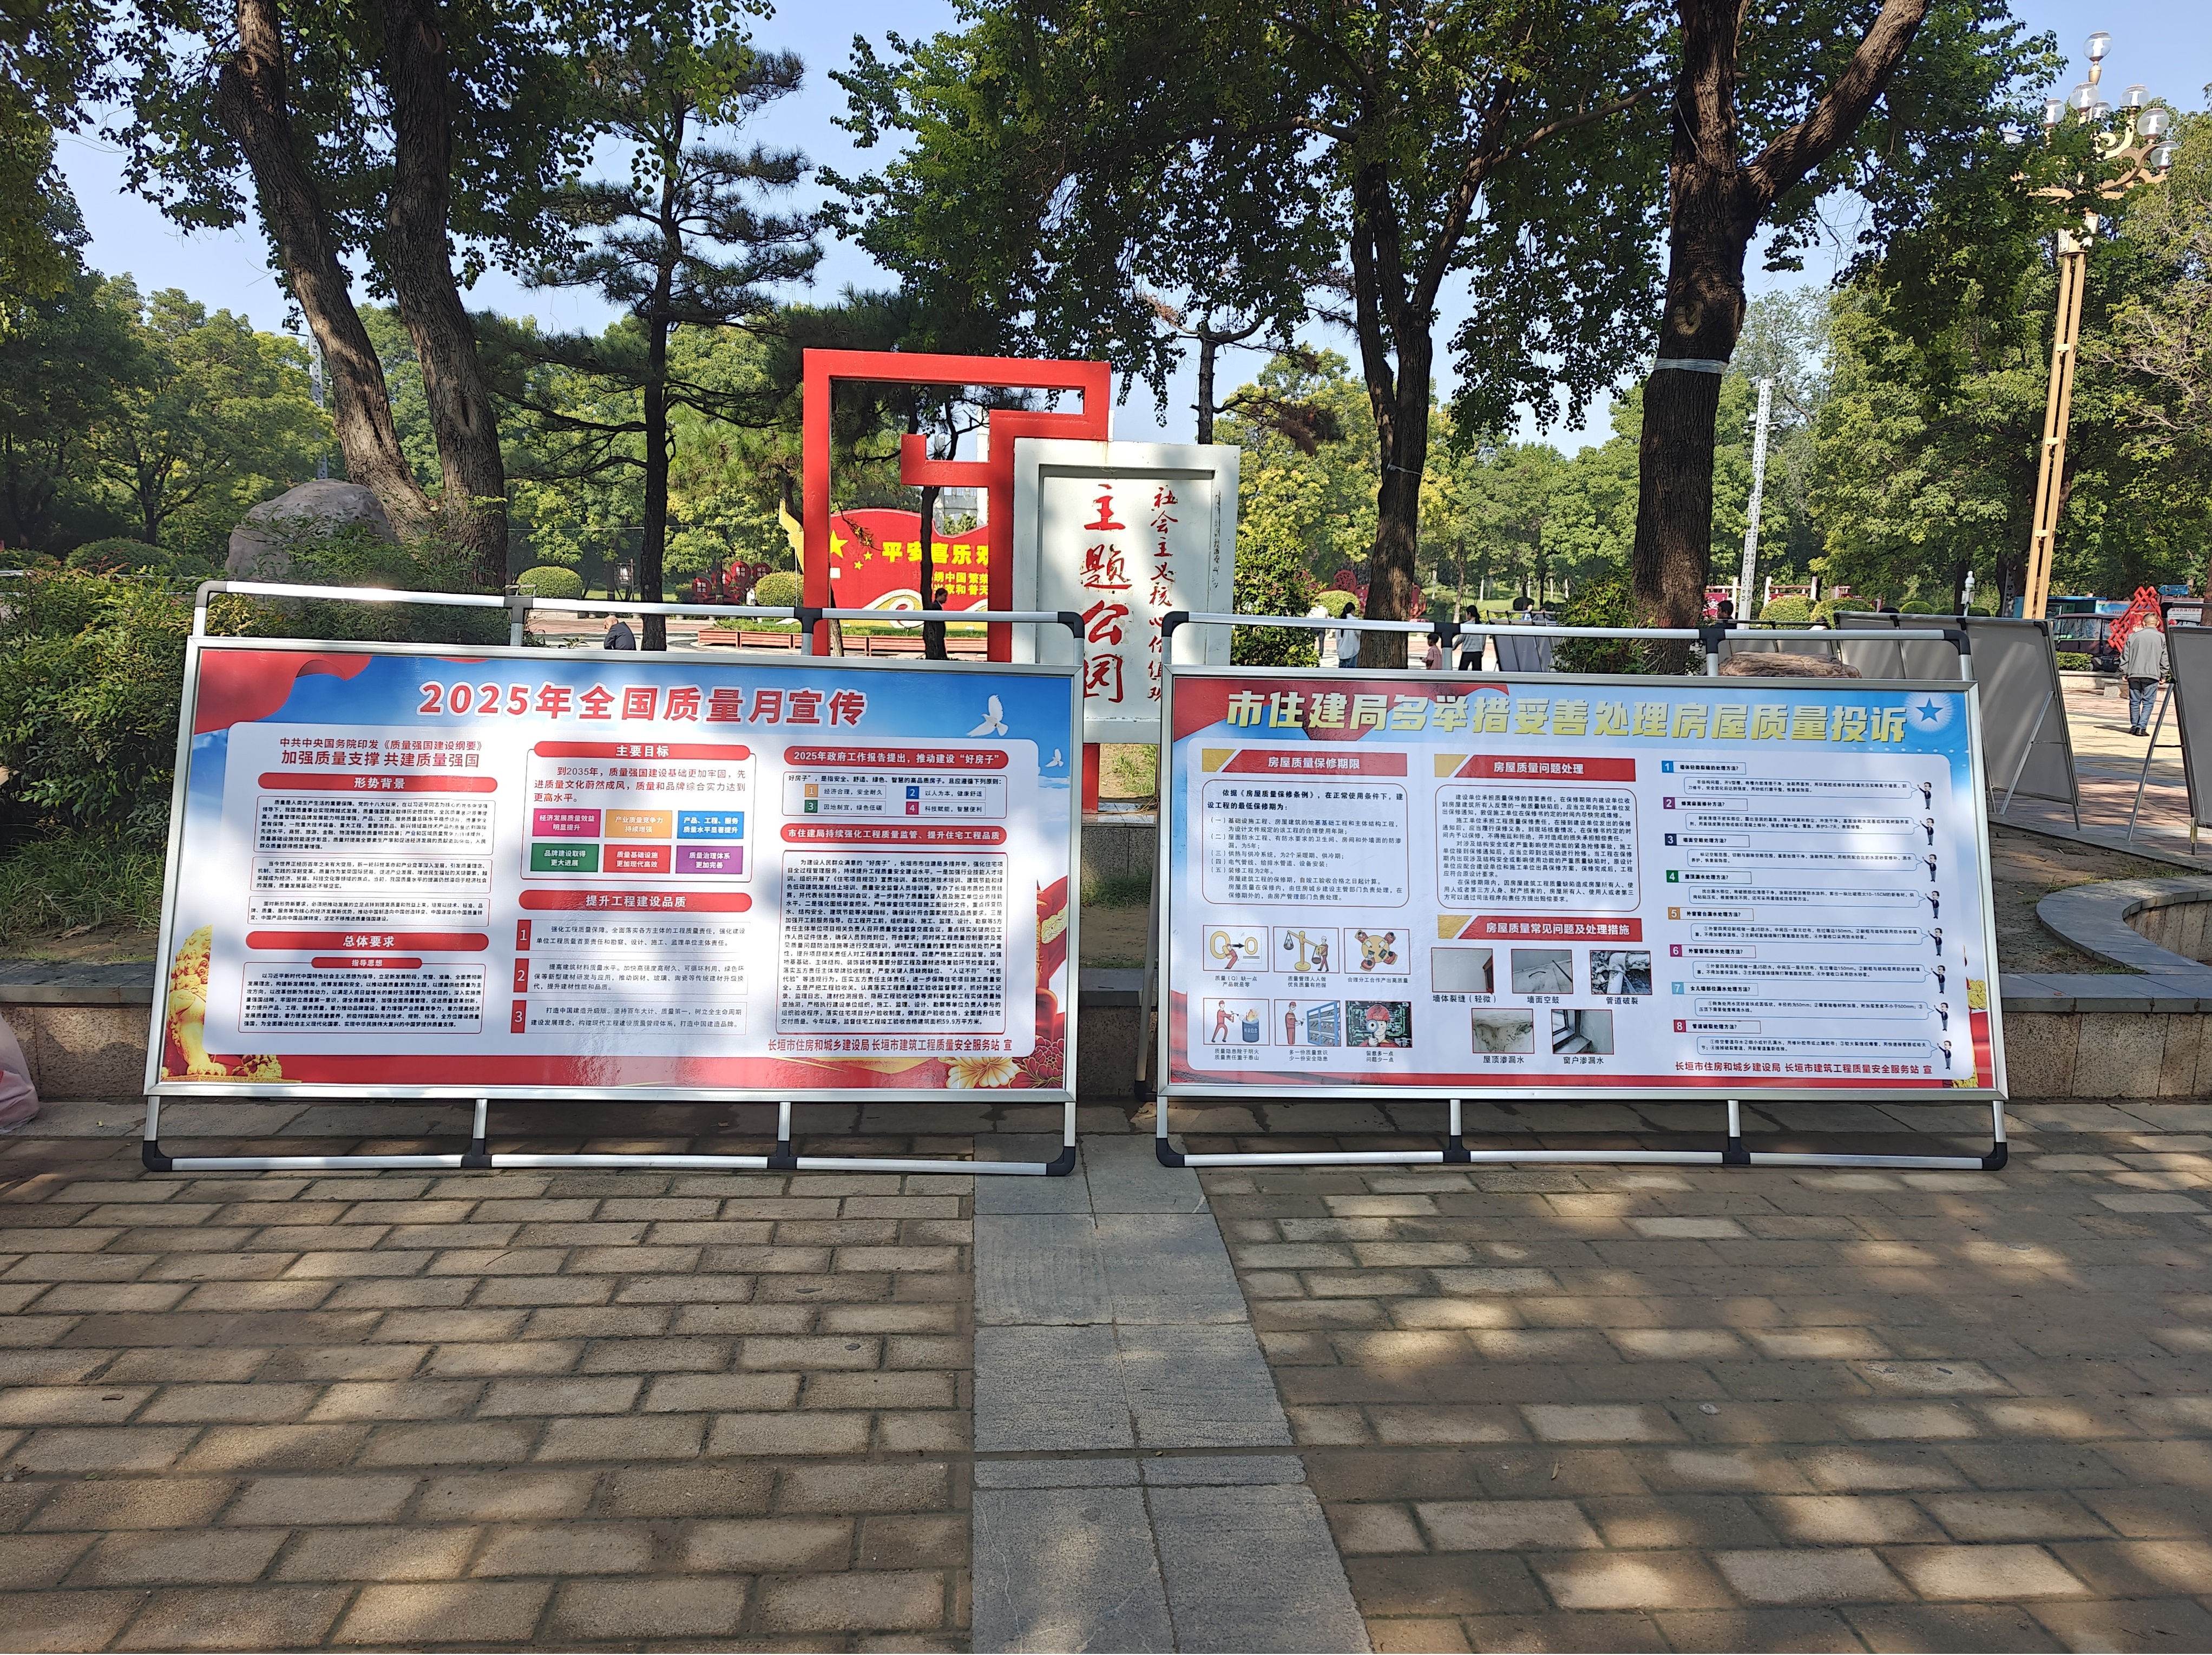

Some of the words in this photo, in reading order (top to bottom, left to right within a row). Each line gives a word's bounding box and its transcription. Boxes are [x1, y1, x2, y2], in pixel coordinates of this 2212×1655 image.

[931, 571, 966, 583] 绣中国
[931, 583, 966, 595] 家和
[1079, 483, 1132, 703] 主题公园
[417, 682, 867, 727] 2025年全国质量月宣传
[1227, 690, 1907, 743] 市住建局多举措妥善处理房屋质量投诉
[279, 737, 483, 751] 中共中央国务院印发《质量强国建设纲要》
[615, 745, 669, 757] 主要目标
[281, 750, 380, 767] 加强质量支撑
[383, 753, 480, 768] 共建质量强国
[793, 752, 1000, 764] 2025年政府工作报告提出，推动建设“好房子”
[1268, 756, 1361, 770] 房屋质量保修期限
[1665, 763, 1670, 771] 1
[556, 766, 746, 779] 到2035年，质量强国建设基础更加牢固，先
[1494, 762, 1584, 775] 房屋质量问题处理
[353, 776, 406, 789] 形势背景
[534, 779, 746, 792] 进质量文化蔚然成风，质量和品牌综合实力达到
[909, 788, 916, 796] 2
[1222, 789, 1404, 801] 依据《房屋质量保修条例》，在正常使用条件下，建
[534, 793, 578, 802] 更高水平。
[808, 802, 814, 810] 3
[823, 803, 883, 812] 因地制宜，绿色低碳
[1207, 801, 1288, 811] 设工程的最低保修期为：
[1666, 799, 1672, 807] 2
[909, 804, 916, 812] 4
[539, 814, 595, 822] 经济发展质量效益
[684, 816, 738, 825] 产品、工程、服务
[625, 825, 653, 833] 持续增强
[683, 826, 738, 834] 质量水平显著提升
[1228, 826, 1348, 835] 为设计文件规定的该工程的合理使用年限；
[787, 828, 1000, 840] 市住建局持续强化工程质量监管、提升住宅工程品质
[1668, 835, 1673, 843] 3
[616, 851, 659, 859] 质量基础设施
[688, 852, 731, 860] 质量治理体系
[550, 859, 579, 867] 更大进展
[616, 860, 658, 868] 更加现代高效
[695, 861, 723, 869] 更加完善
[1443, 870, 1499, 878] 应符合原设计要求。
[1669, 872, 1675, 881] 4
[1228, 875, 1381, 885] 房屋建筑工程的保修期，自竣工验收合格之日起计算。
[1228, 884, 1403, 894] 房屋质量在保修内，由住房城乡建设主管部门负责处理，在
[1228, 892, 1342, 901] 保修期外的，由房产管理部门负责处理。
[585, 895, 687, 908] 提升工程建设品质
[1671, 910, 1677, 918] 5
[1486, 923, 1630, 936] 房屋质量常见问题及处理措施
[520, 930, 528, 941] 1
[343, 936, 395, 947] 总体要求
[1673, 946, 1679, 954] 6
[517, 970, 526, 982] 2
[1675, 984, 1681, 992] 7
[1432, 995, 1496, 1004] 墙体裂缝（轻微）
[1527, 996, 1560, 1004] 墙面空鼓
[1606, 997, 1638, 1005] 管道破裂
[514, 1011, 523, 1023] 3
[1677, 1022, 1683, 1030] 8
[768, 1039, 870, 1052] 长垣市住房和城乡建设局
[872, 1038, 1000, 1051] 长垣市建筑工程质量安全服务站
[1004, 1039, 1012, 1051] 宣
[1483, 1056, 1524, 1064] 屋顶渗漏水
[1563, 1056, 1604, 1065] 窗户渗漏水
[1676, 1061, 1781, 1072] 长垣市住房和城乡建设局
[1785, 1063, 1919, 1074] 长垣市建筑工程质量安全服务站
[1923, 1064, 1933, 1074] 宣
